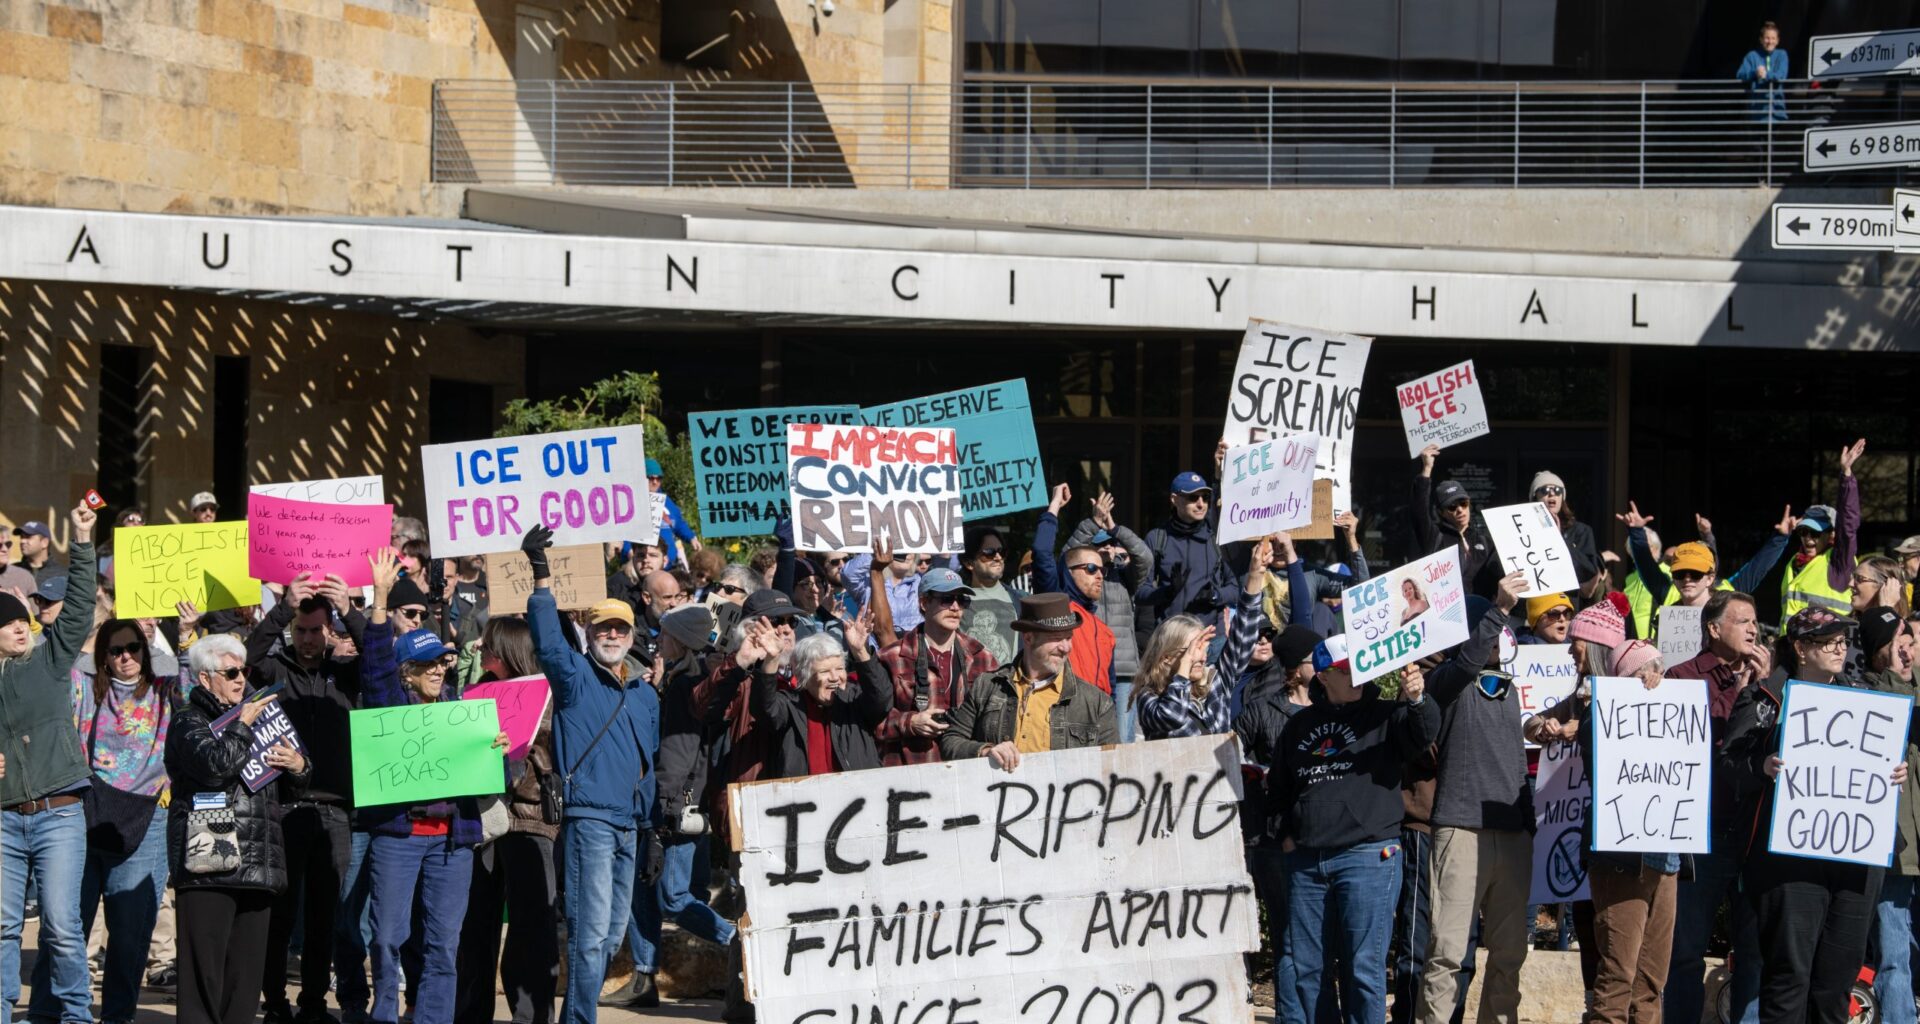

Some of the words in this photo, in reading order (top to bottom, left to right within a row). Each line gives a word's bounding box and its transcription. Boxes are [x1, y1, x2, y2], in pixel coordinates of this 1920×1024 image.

[1850, 43, 1896, 63] 6937mi
[1849, 134, 1920, 155] 6988m
[1821, 217, 1893, 237] 7890mi
[66, 224, 698, 293] AUSTIN
[890, 264, 1231, 313] CITY
[1411, 286, 1745, 331] HALL
[1253, 331, 1347, 378] ICE
[1398, 364, 1473, 410] ABOLISH
[861, 407, 895, 428] WE
[902, 388, 1004, 427] DESERVE
[1231, 373, 1362, 440] SCREAMS
[1415, 393, 1457, 425] ICE
[696, 416, 741, 439] WE
[1408, 426, 1426, 438] THE
[1428, 418, 1450, 430] REAL
[1422, 422, 1461, 442] DOMESTIC
[1440, 421, 1487, 443] TERRORISTS
[700, 441, 788, 468] CONSTI
[790, 423, 958, 468] IMPEACH
[956, 442, 986, 465] VE
[456, 446, 521, 487] ICE
[543, 436, 617, 478] OUT
[958, 457, 1037, 490] IGNITY
[1232, 442, 1275, 484] ICE
[1283, 440, 1316, 474] OUT
[335, 482, 380, 502] OUT
[704, 470, 789, 495] FREEDOM
[960, 481, 1034, 512] MANITY
[1251, 480, 1261, 496] of
[1266, 480, 1280, 491] our
[255, 503, 273, 519] We
[277, 508, 325, 522] defeated
[329, 513, 371, 526] fascism
[447, 495, 522, 541] FOR
[540, 483, 635, 530] GOOD
[708, 498, 791, 524] HUMAN
[1230, 488, 1309, 525] Community!
[257, 522, 270, 536] 81
[275, 529, 297, 539] years
[800, 498, 965, 552] REMOVE
[130, 527, 248, 566] ABOLISH
[254, 540, 277, 556] We
[283, 547, 304, 557] will
[311, 549, 352, 559] defeat
[143, 558, 198, 584] ICE
[548, 556, 571, 570] OT
[1423, 560, 1454, 584] Justice
[134, 583, 216, 613] NOW
[511, 576, 535, 594] MA
[553, 573, 573, 588] AT
[1348, 576, 1389, 614] ICE
[710, 601, 723, 616] NO
[1667, 609, 1700, 621] AMER
[1673, 625, 1686, 635] IS
[1355, 620, 1427, 673] CITIES!
[1661, 640, 1702, 654] EVERY
[1526, 662, 1577, 678] MEANS
[254, 713, 291, 747] MAKE
[371, 704, 433, 738] ICE
[447, 702, 494, 726] OUT
[1595, 698, 1709, 745] VETERAN
[1790, 706, 1894, 762] I.C.E.
[401, 732, 437, 759] OF
[1297, 722, 1357, 751] PLAYSTATION
[1547, 740, 1583, 761] CHI
[242, 758, 263, 780] US
[369, 757, 450, 792] TEXAS
[1617, 759, 1701, 790] AGAINST
[1785, 764, 1888, 805] KILLED
[1543, 796, 1592, 825] MIGR
[1605, 794, 1695, 845] I.C.E.
[765, 768, 1240, 886] ICE-RIPPING
[1787, 808, 1875, 854] GOOD
[783, 894, 1044, 977] FAMILIES
[1082, 884, 1253, 954] APART
